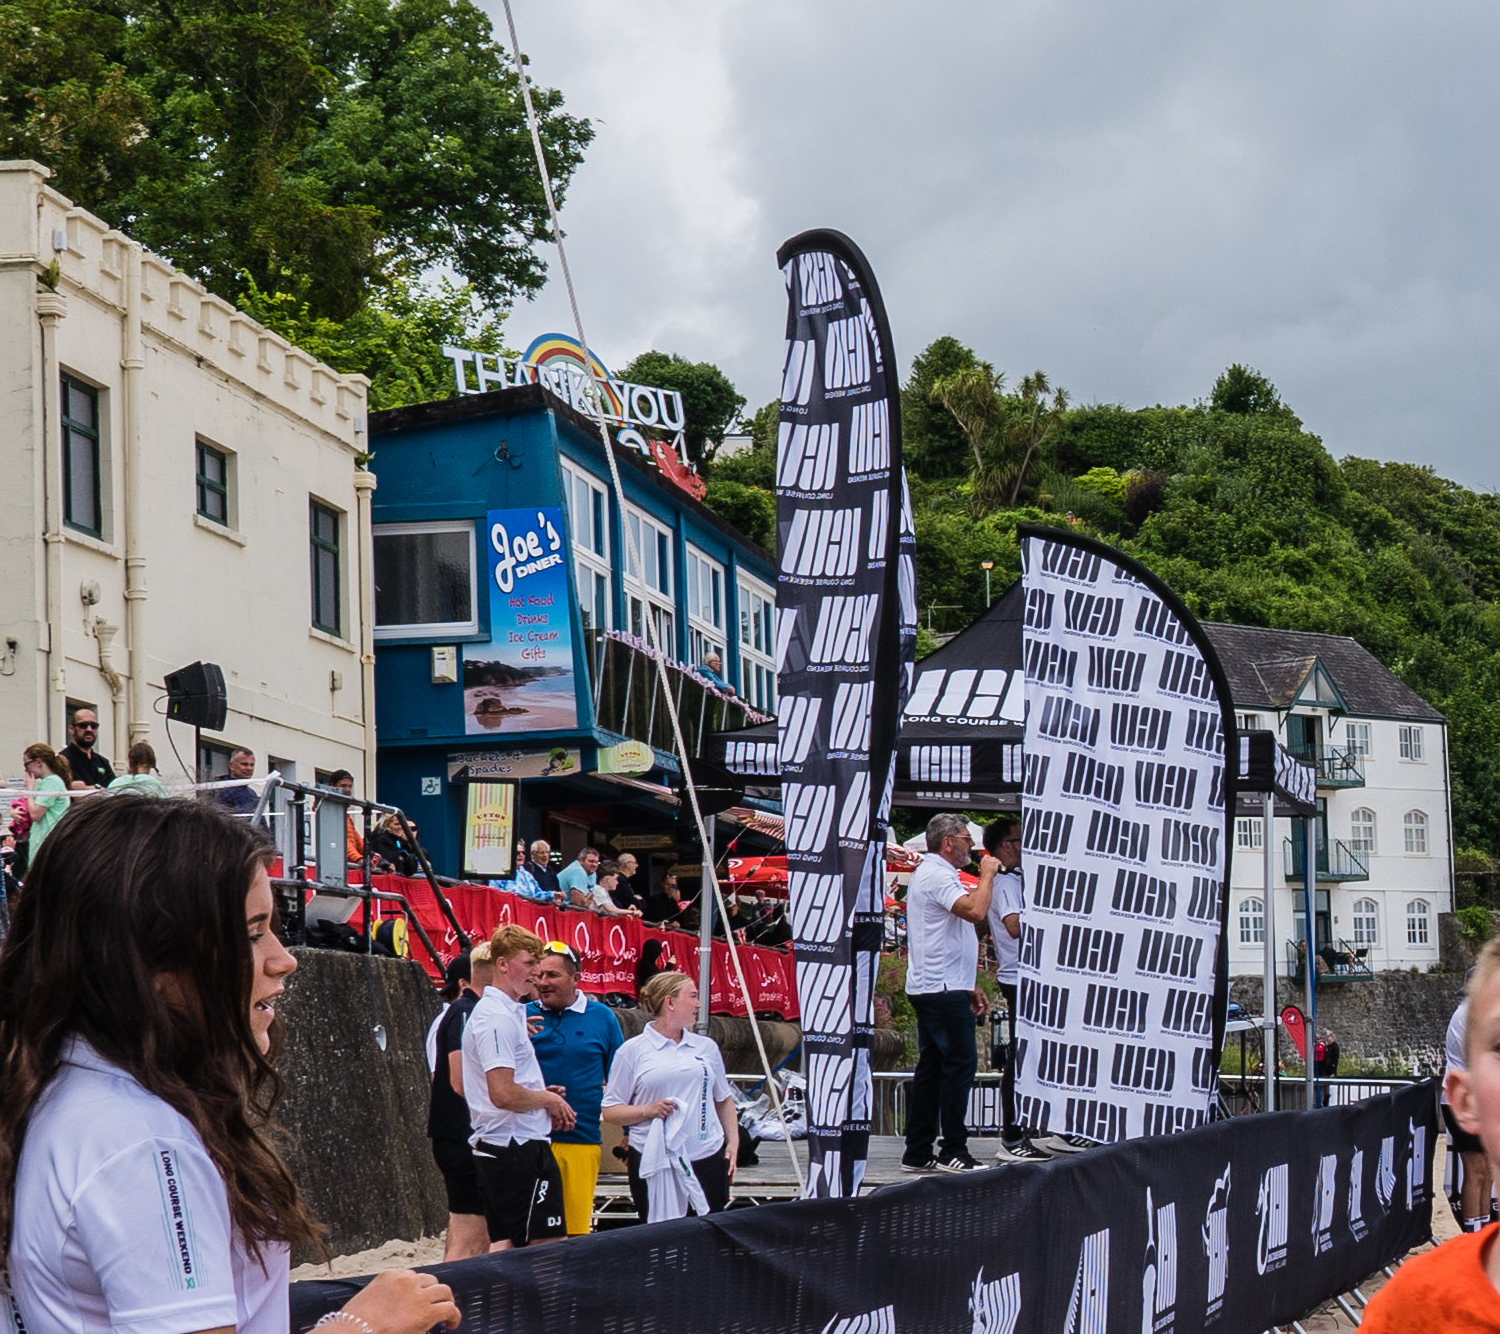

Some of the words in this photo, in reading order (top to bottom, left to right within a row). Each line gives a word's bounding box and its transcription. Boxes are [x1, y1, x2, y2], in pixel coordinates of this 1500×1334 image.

[442, 345, 599, 417] THANK
[607, 378, 686, 432] YOU
[491, 511, 561, 593] Joe's
[515, 553, 564, 578] DINER
[509, 596, 525, 607] Hot
[528, 593, 554, 607] Food
[508, 632, 524, 643] Ice
[527, 631, 558, 642] Cream
[945, 717, 1009, 726] COURSE
[160, 1149, 175, 1177] LONG
[166, 1178, 184, 1219] COURSE
[547, 1216, 562, 1227] DJ
[175, 1220, 192, 1275] WEEKEND
